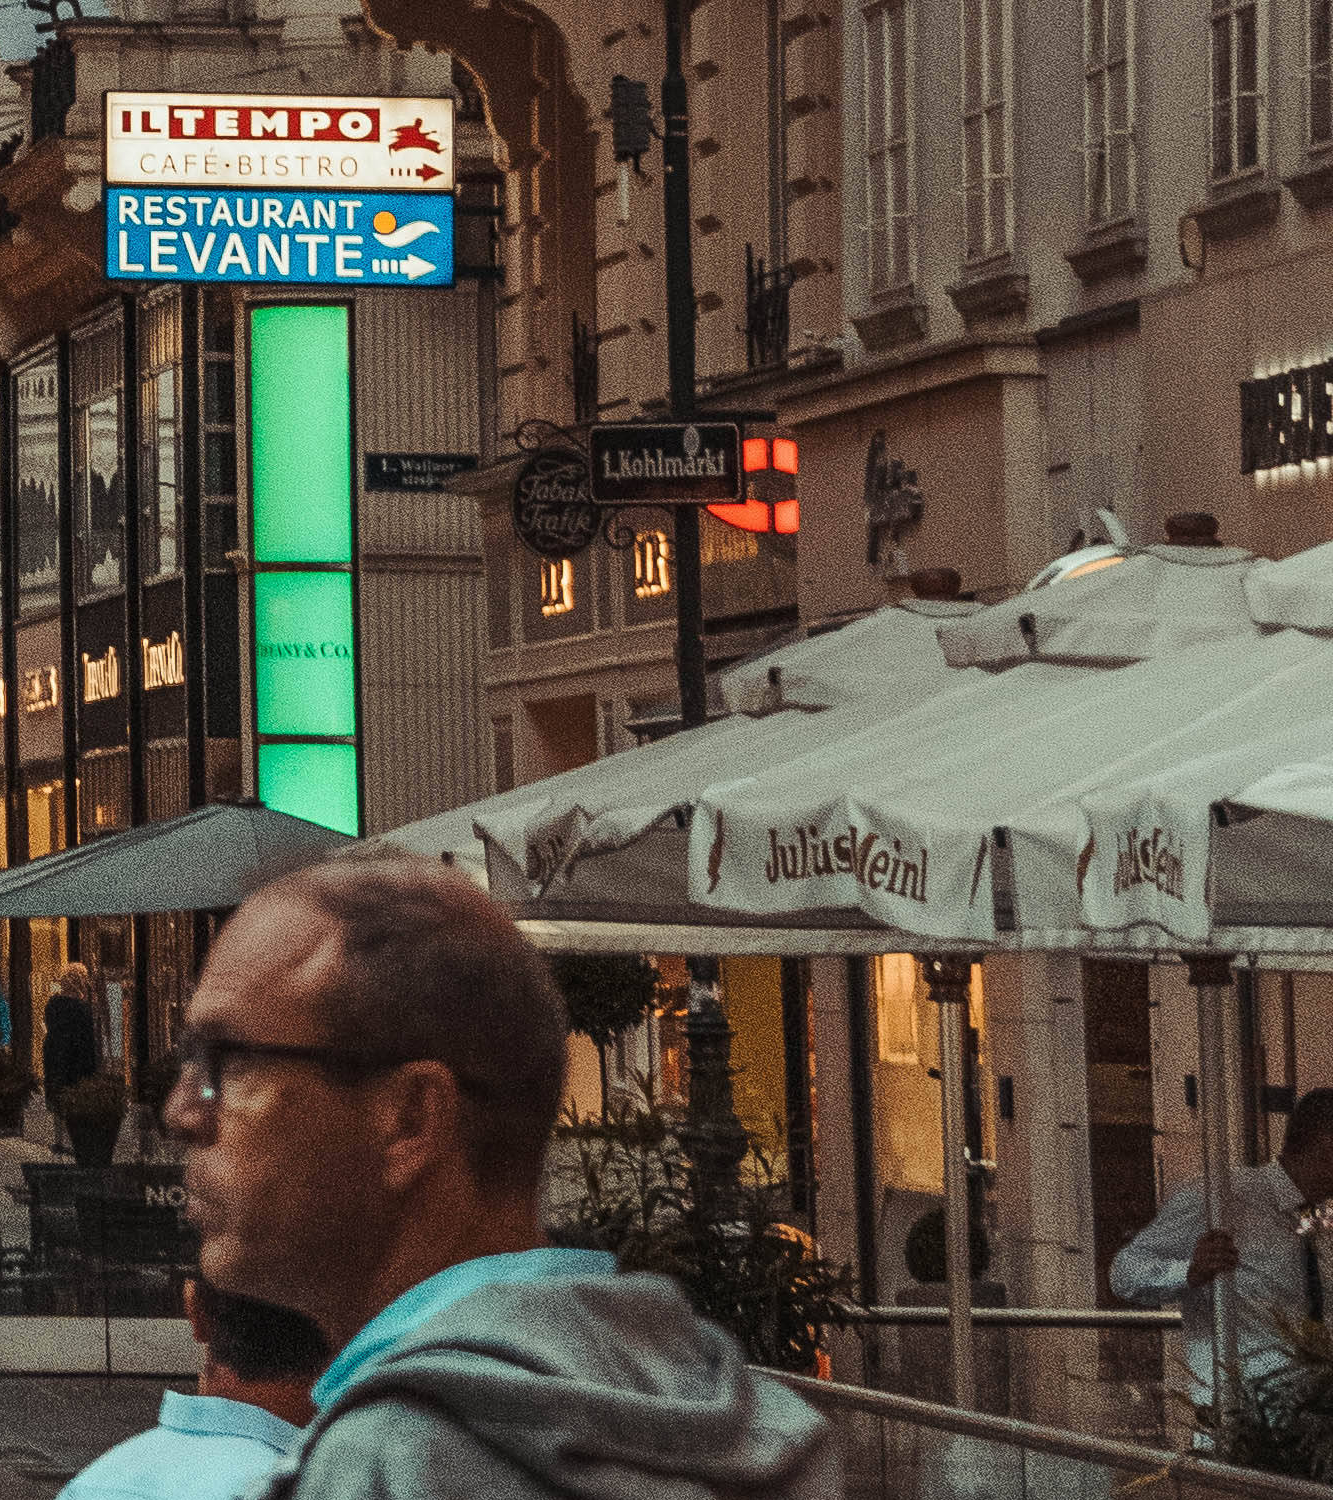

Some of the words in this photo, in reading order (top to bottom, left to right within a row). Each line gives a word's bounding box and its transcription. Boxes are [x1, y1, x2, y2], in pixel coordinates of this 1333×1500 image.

[121, 110, 161, 134] IL
[175, 108, 374, 138] TEMPO
[237, 155, 359, 178] BISTRO
[118, 196, 362, 229] RESTAURANT
[119, 230, 363, 278] LEVANTE
[765, 822, 858, 885] Julius
